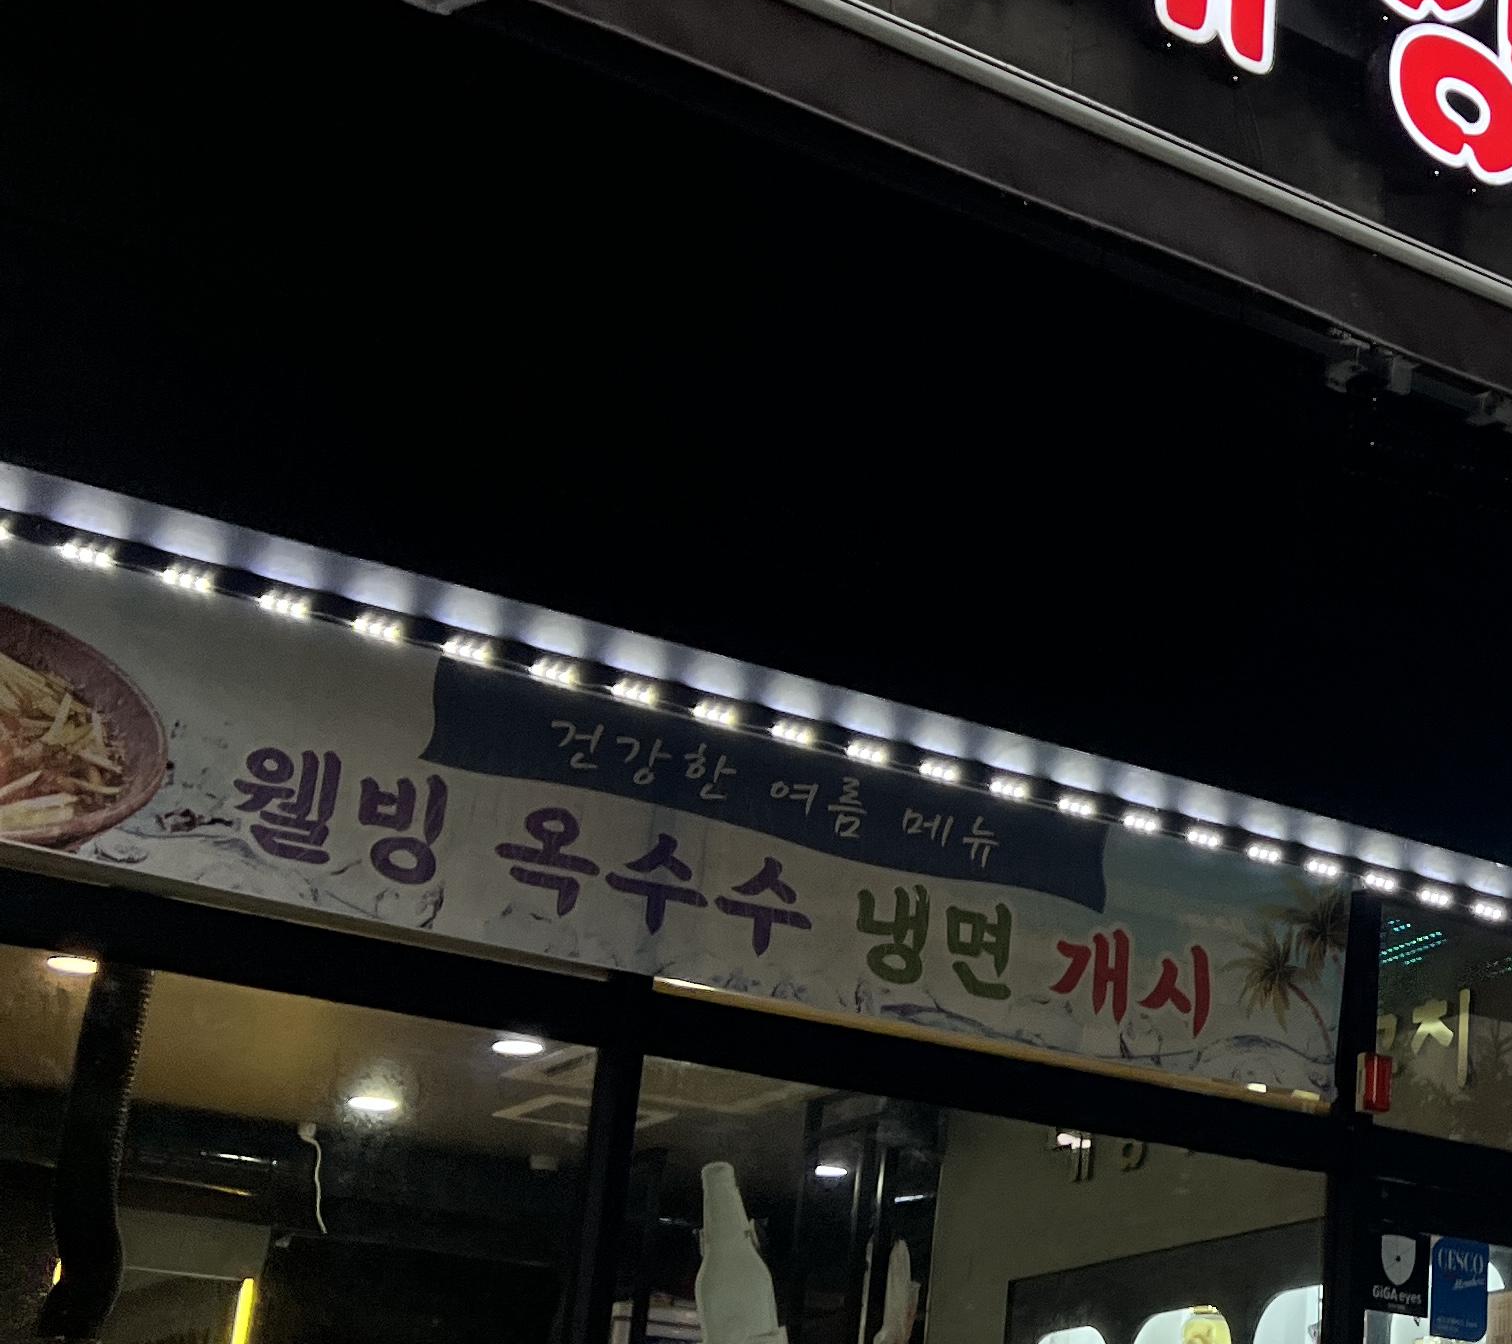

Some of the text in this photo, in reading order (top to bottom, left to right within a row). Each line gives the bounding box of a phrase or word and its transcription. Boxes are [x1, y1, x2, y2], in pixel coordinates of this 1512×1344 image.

[551, 719, 999, 869] 건강한 여름 메뉴
[233, 747, 1211, 1039] 웰빙 옥수수 냉면 개시
[1437, 1246, 1484, 1274] CESCO
